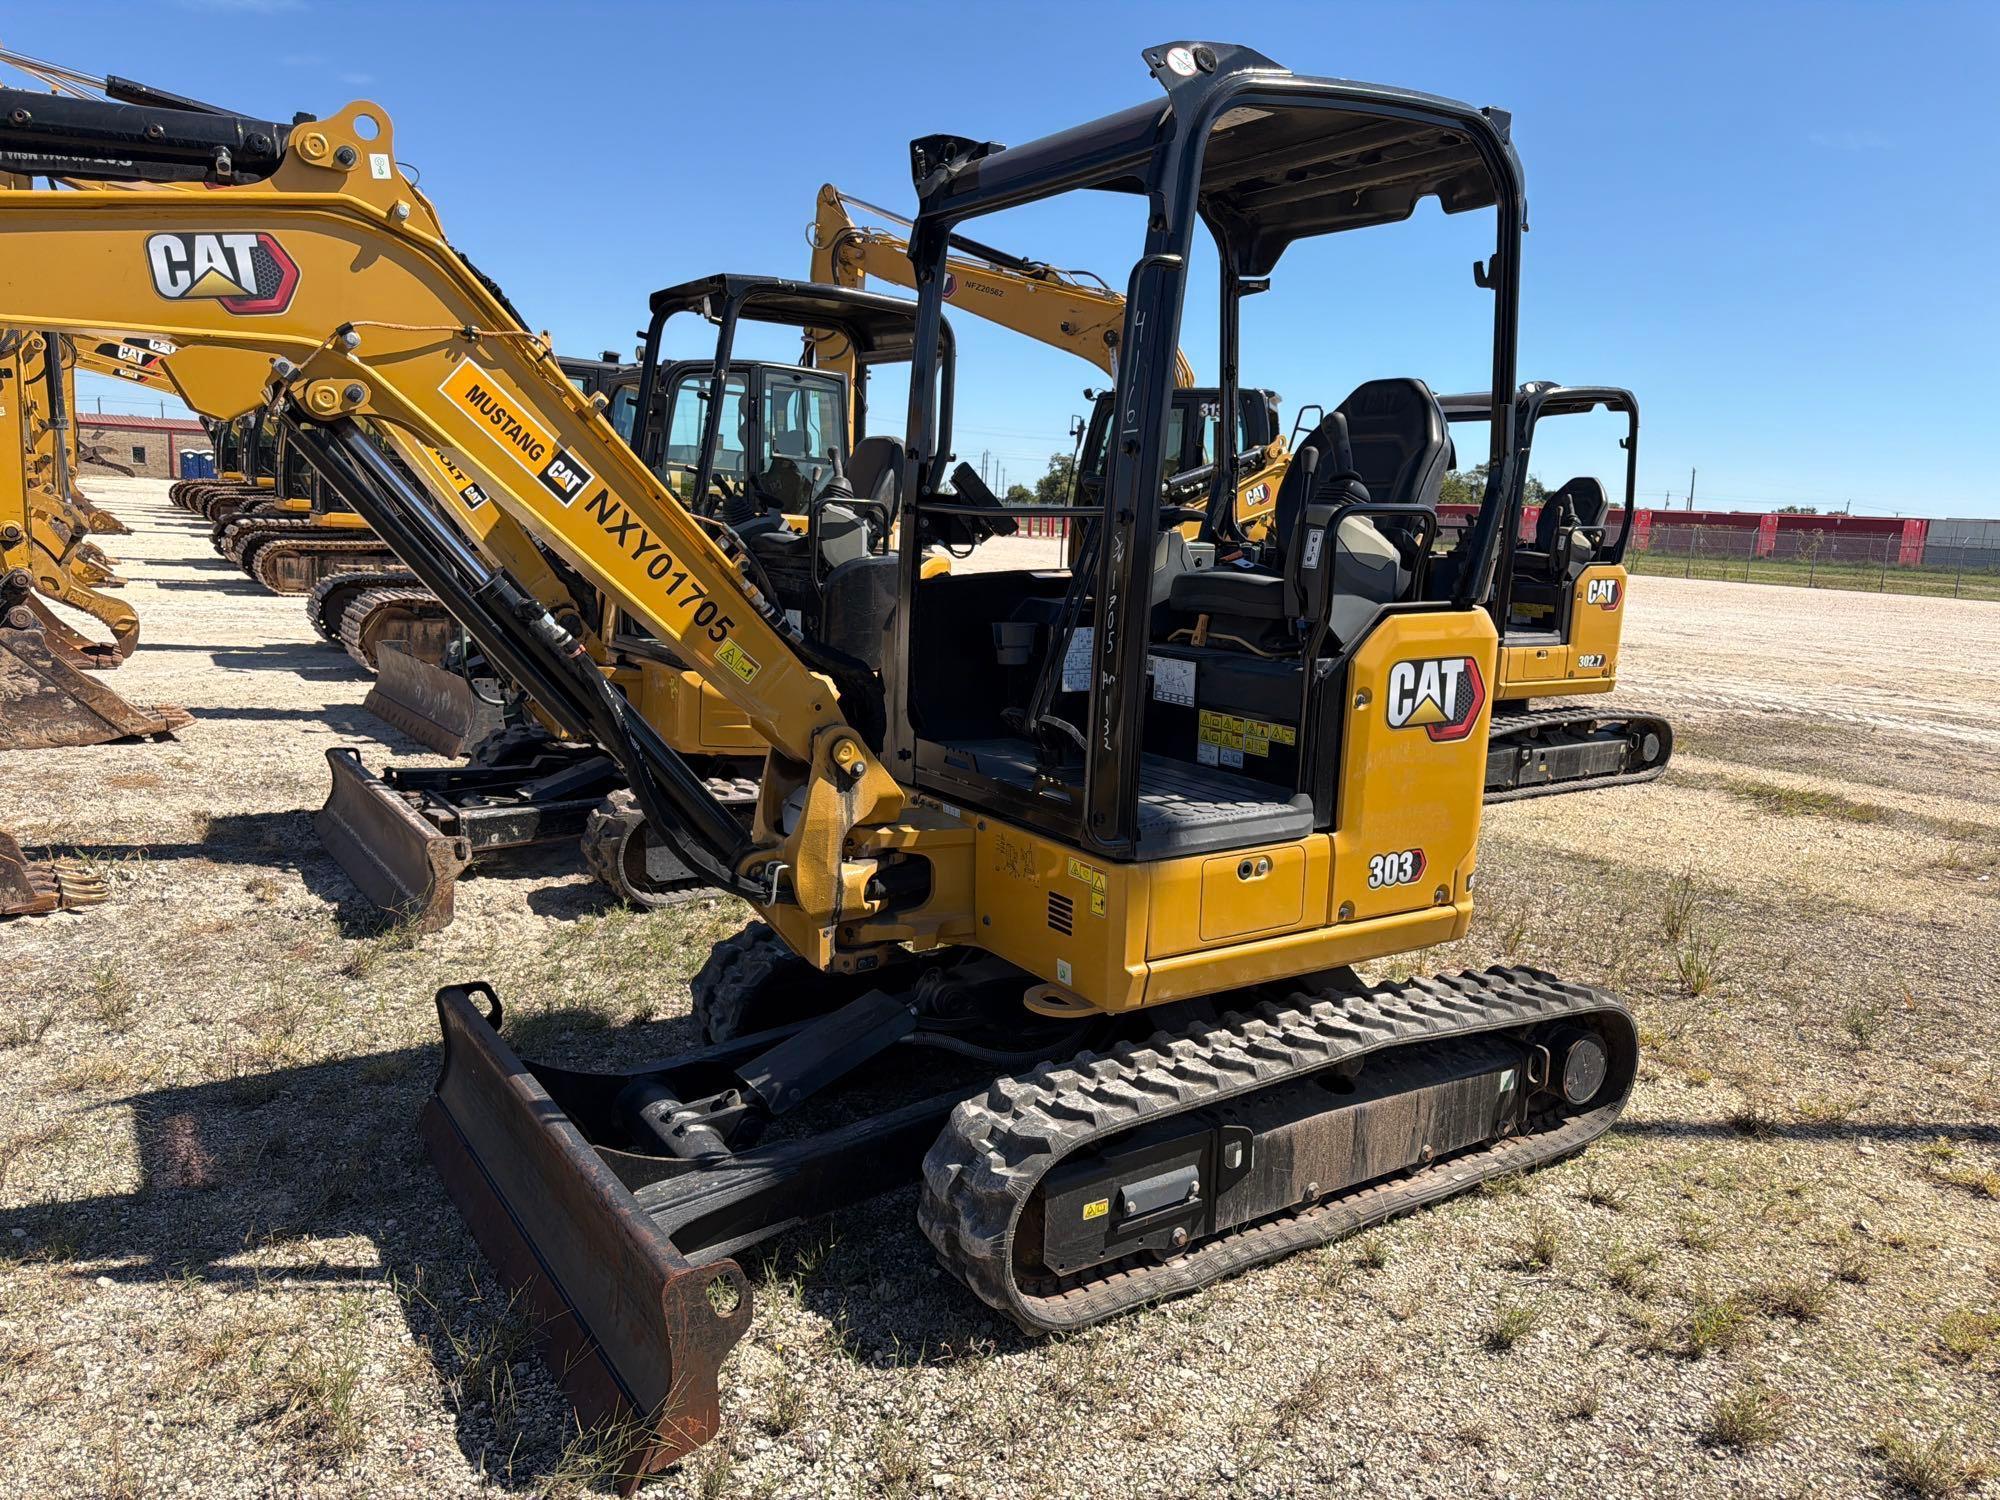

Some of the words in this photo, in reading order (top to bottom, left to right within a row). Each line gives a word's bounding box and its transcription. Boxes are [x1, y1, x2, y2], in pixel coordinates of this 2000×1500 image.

[148, 234, 259, 298] CAT
[117, 344, 146, 365] CAT
[464, 383, 546, 462] MUSTANG
[547, 459, 584, 493] CAT
[433, 448, 467, 482] OLT
[464, 486, 483, 505] CAT
[1245, 483, 1266, 506] CAT
[584, 487, 736, 643] NXY01705
[1587, 579, 1616, 604] CAT
[1578, 654, 1603, 668] 302.7
[1387, 658, 1466, 727] CAT
[1368, 850, 1414, 889] 303
